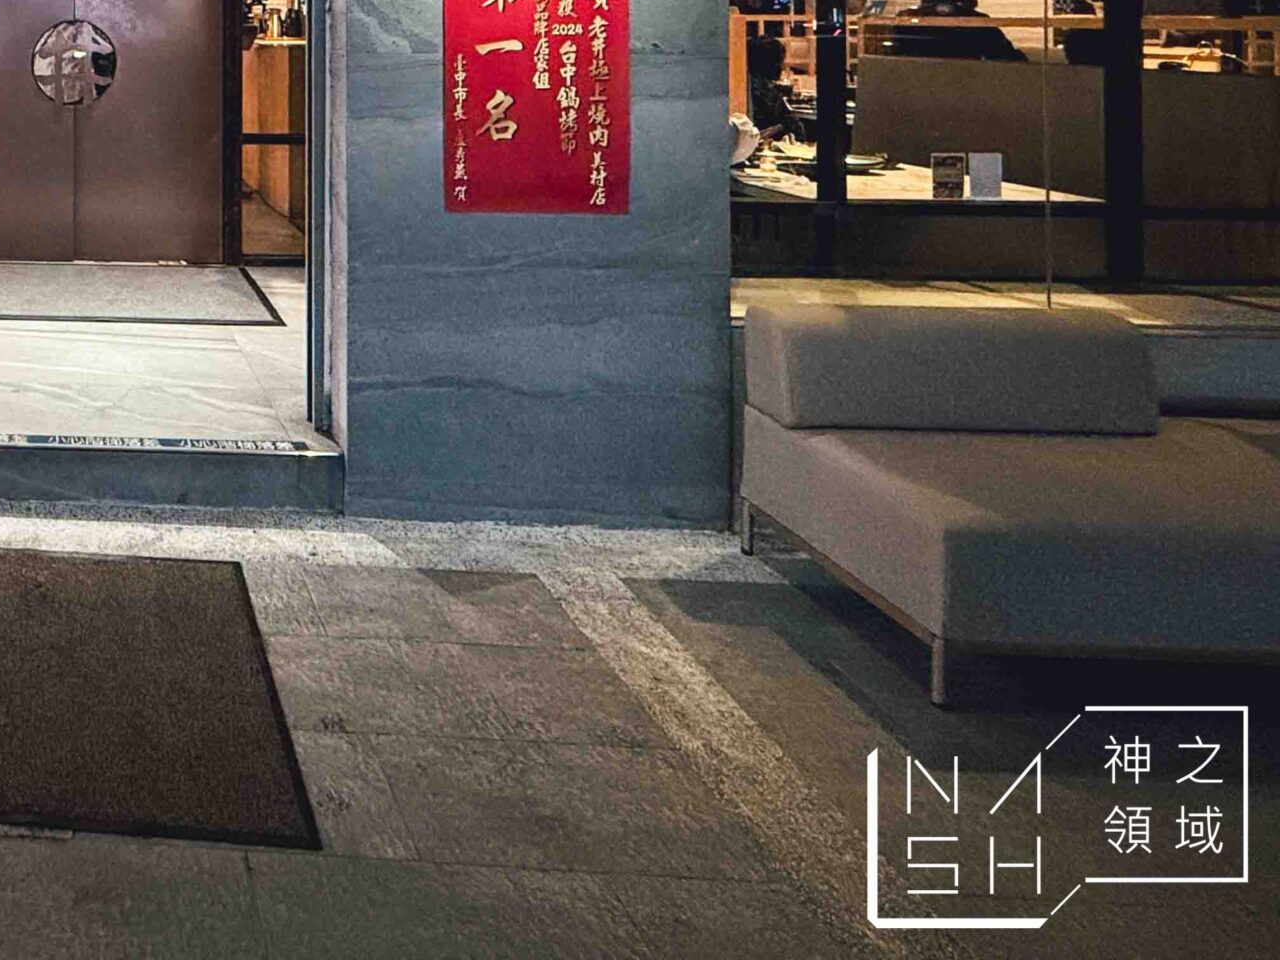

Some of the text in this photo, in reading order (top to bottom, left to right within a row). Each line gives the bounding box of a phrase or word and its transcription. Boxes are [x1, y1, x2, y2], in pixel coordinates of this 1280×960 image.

[551, 23, 583, 36] 2024
[555, 40, 581, 155] 台中鍋烤節
[587, 15, 611, 148] 老井極上燒肉
[589, 151, 609, 206] 美村店
